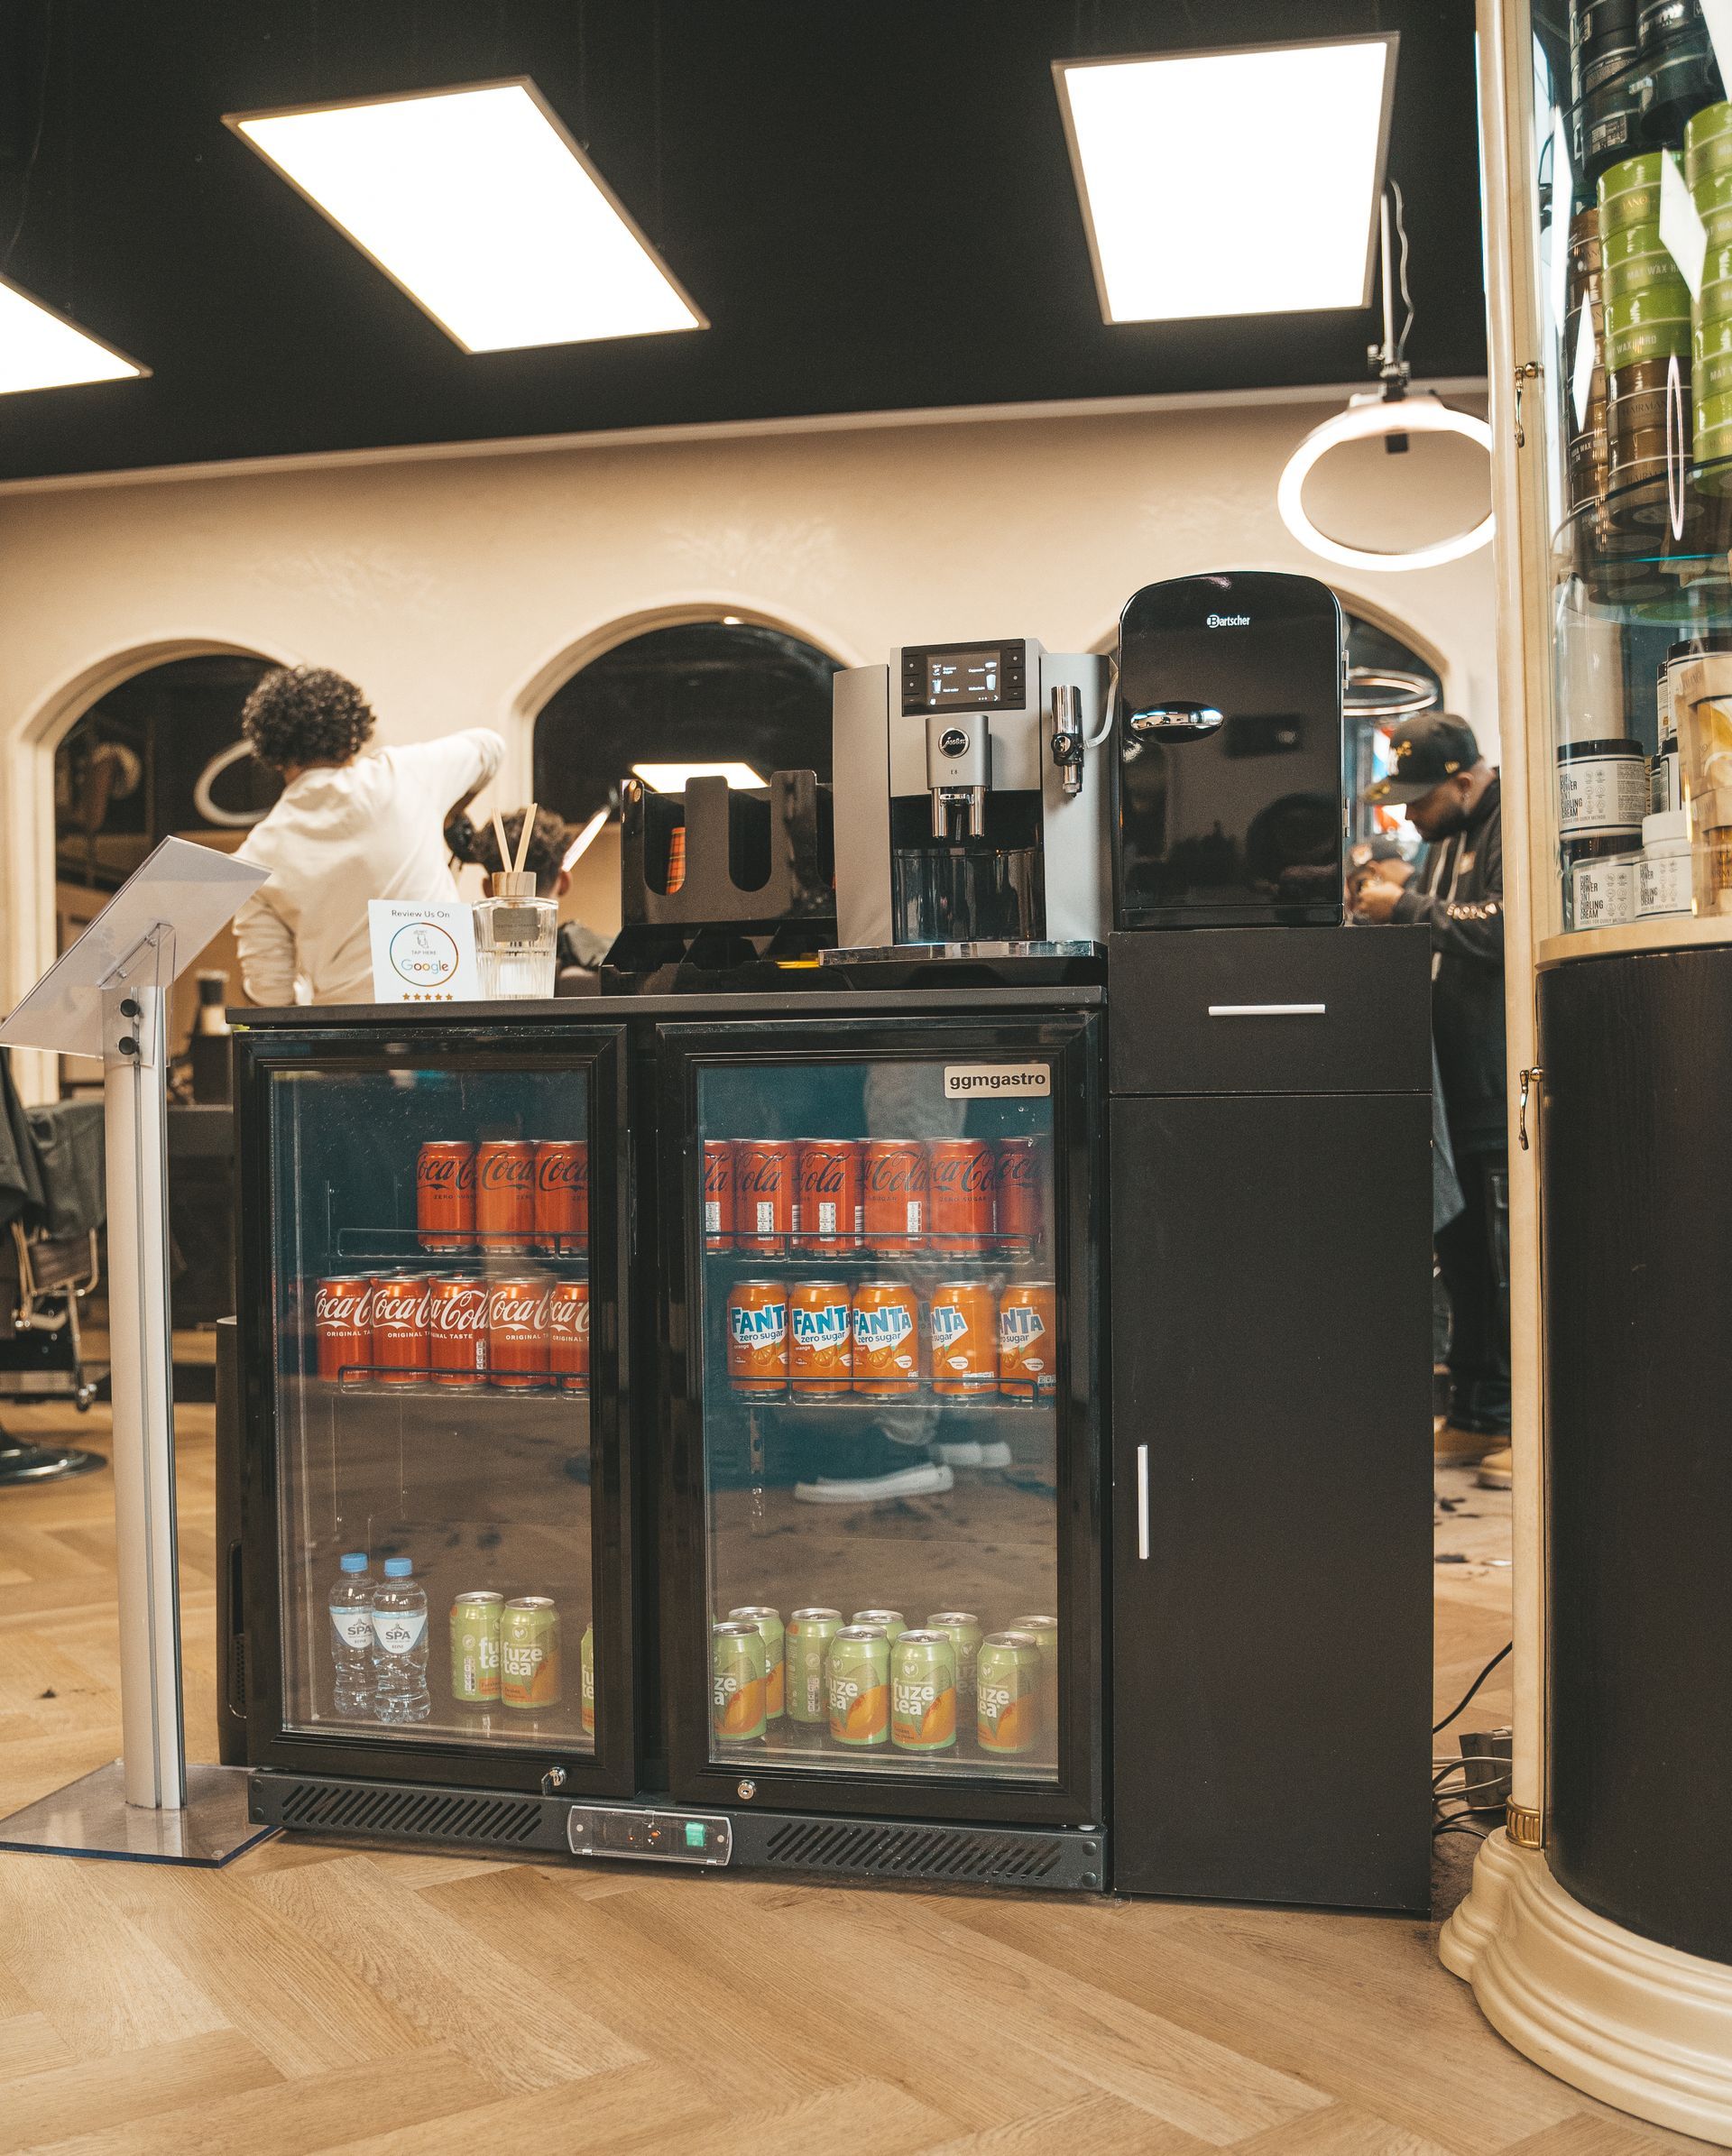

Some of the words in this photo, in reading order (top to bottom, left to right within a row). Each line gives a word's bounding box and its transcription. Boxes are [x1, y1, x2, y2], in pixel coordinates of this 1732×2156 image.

[1207, 614, 1250, 629] Bartscher
[392, 909, 422, 918] Review
[424, 910, 436, 918] Us
[437, 910, 450, 918] On
[401, 959, 449, 975] Google
[950, 1073, 1046, 1090] ggmgastro
[793, 1306, 852, 1335] FANTA
[853, 1308, 912, 1336] FANTA
[740, 1332, 759, 1341] zero
[760, 1330, 784, 1342] sugar
[801, 1334, 820, 1343] zero
[822, 1331, 846, 1342] sugar
[858, 1334, 875, 1343] zero
[875, 1331, 902, 1343] sugar
[934, 1332, 954, 1343] sugar
[1007, 1333, 1030, 1344] sugar
[347, 1626, 372, 1635] SPA
[385, 1631, 410, 1640] SPA
[503, 1642, 543, 1663] fuze
[503, 1660, 532, 1676] tea
[893, 1678, 935, 1700] fuze
[894, 1698, 922, 1716] tea
